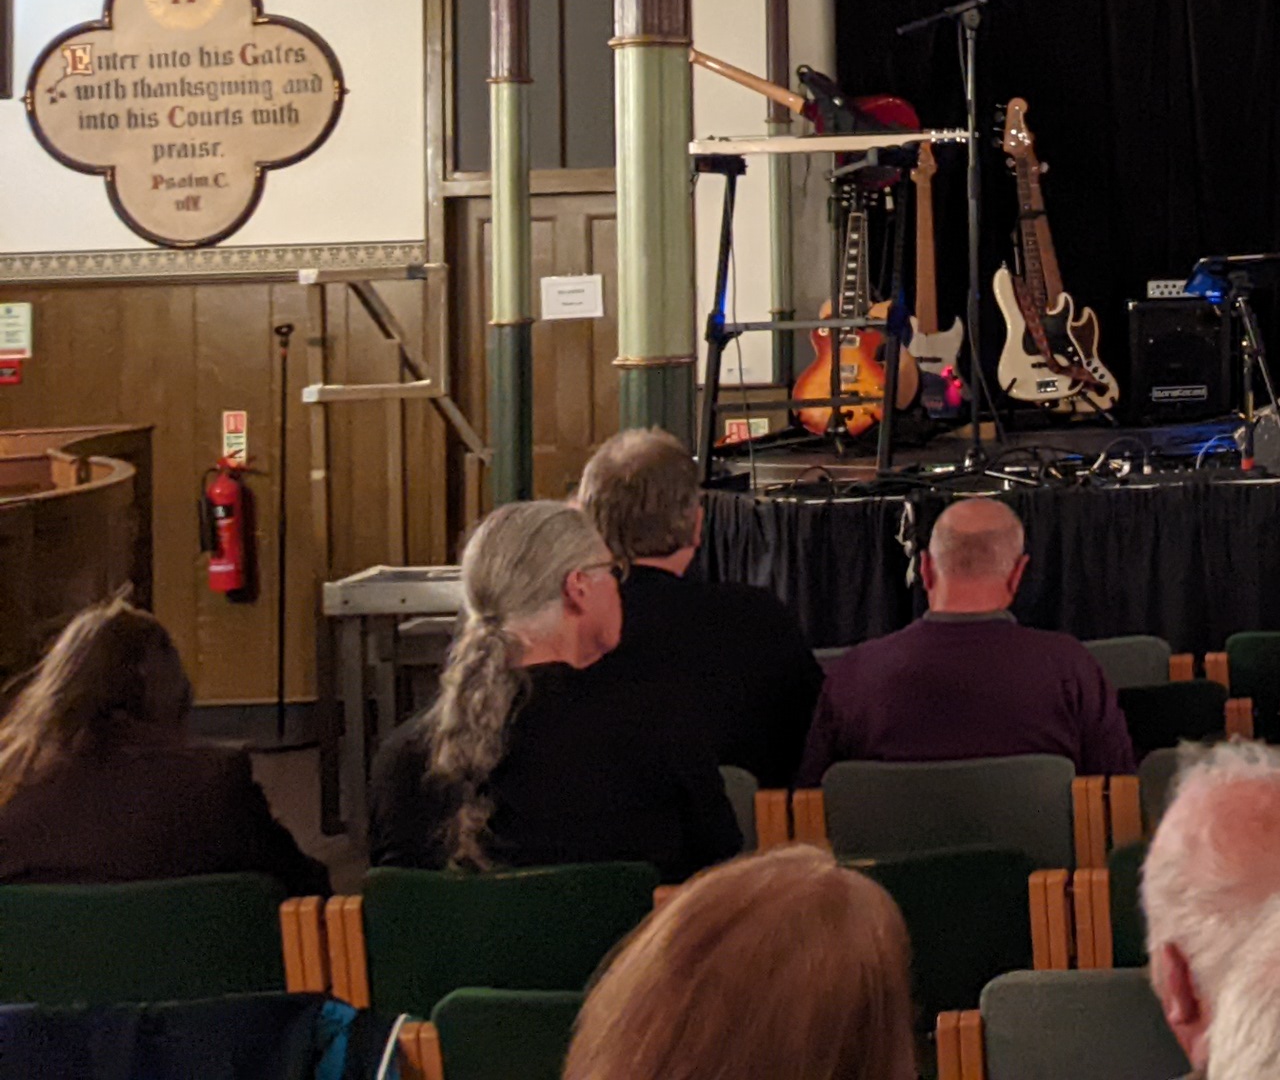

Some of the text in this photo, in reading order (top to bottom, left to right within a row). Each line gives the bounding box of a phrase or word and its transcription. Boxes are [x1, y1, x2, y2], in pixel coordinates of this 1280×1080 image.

[66, 43, 307, 73] Enter into his Gates
[75, 74, 323, 106] with thanksgiving and
[79, 102, 300, 131] into his Courts with
[152, 138, 224, 163] praise.
